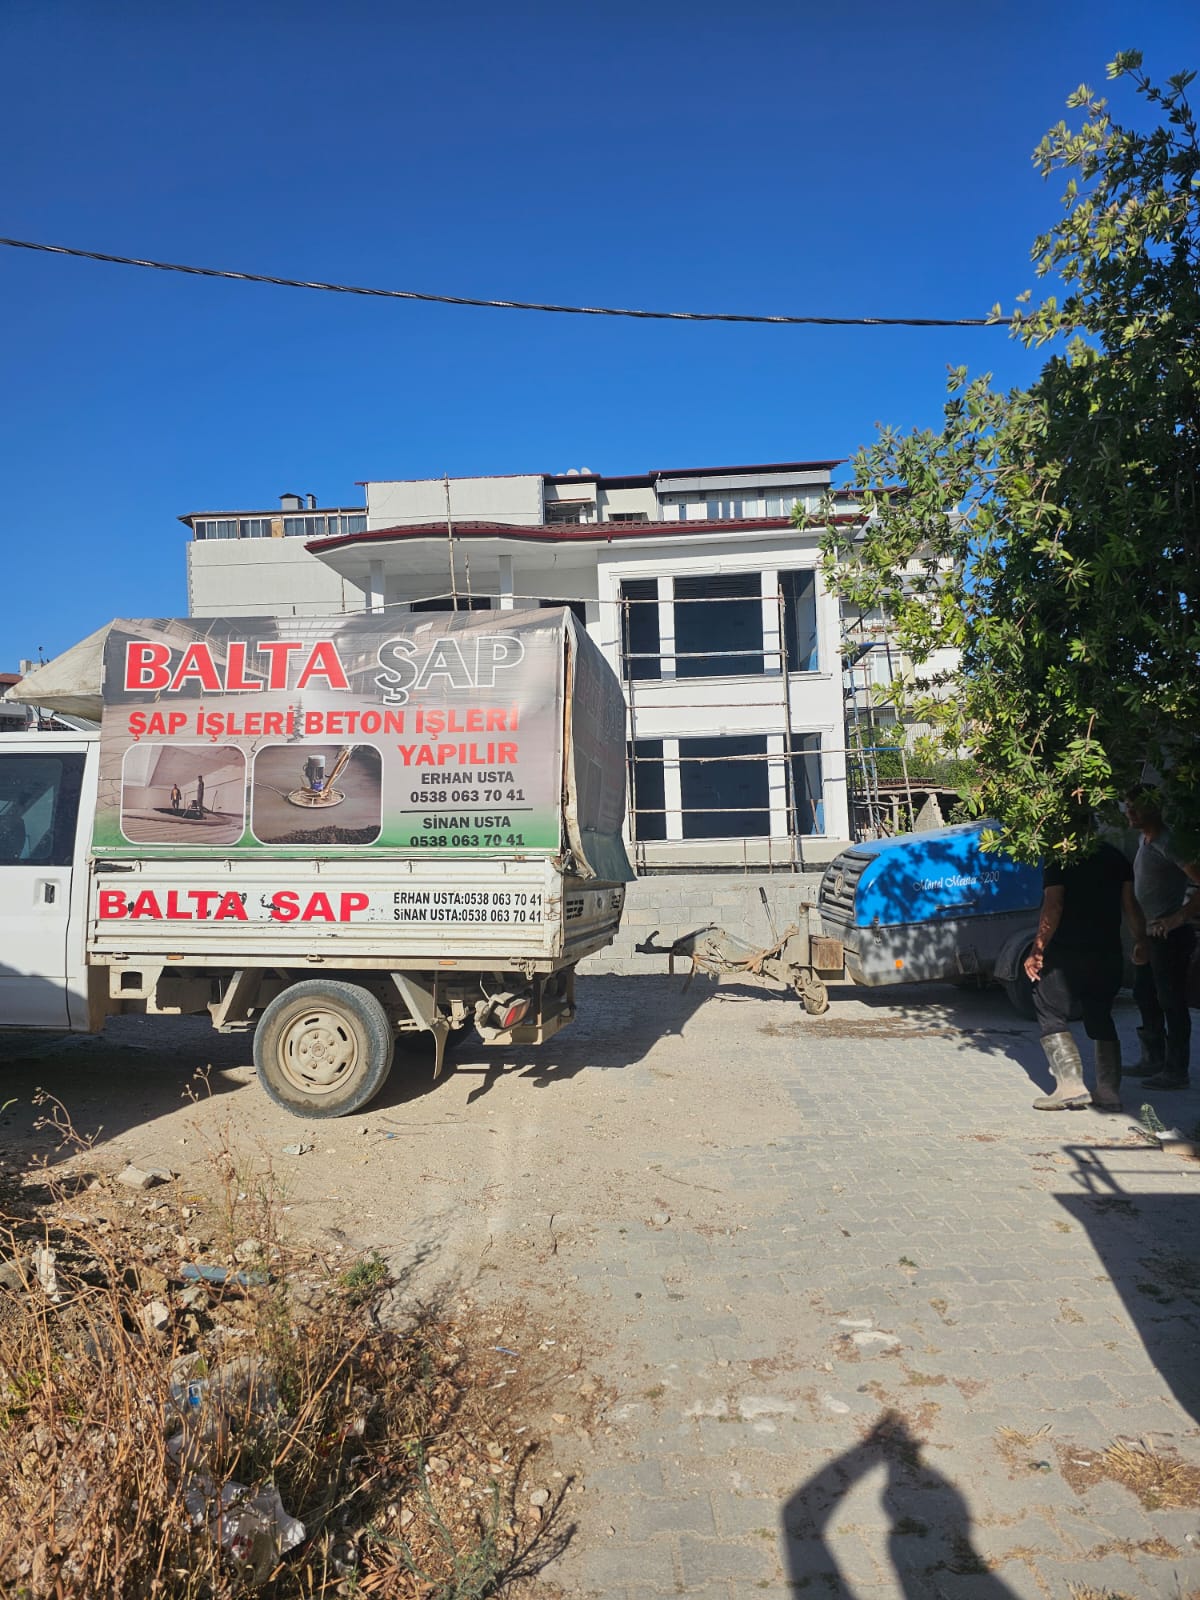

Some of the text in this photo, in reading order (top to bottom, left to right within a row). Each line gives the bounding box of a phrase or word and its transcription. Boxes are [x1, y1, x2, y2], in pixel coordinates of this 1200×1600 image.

[124, 636, 525, 706] BALTA ŞAP
[128, 701, 519, 742] ŞAP İŞLERİ BETON İŞLERİ
[397, 742, 518, 766] YAPILIR
[421, 771, 515, 784] ERHAN USTA
[410, 789, 525, 803] 0538 063 70 41
[422, 814, 511, 829] SİNAN USTA
[410, 834, 525, 847] 0538 063 70 41
[99, 890, 249, 920] BALTA
[393, 892, 542, 906] ERHAN USTA:0538 063 70 41
[430, 909, 487, 921] USTA:0538
[490, 909, 510, 922] 063
[513, 910, 526, 922] 70
[529, 910, 541, 922] 41
